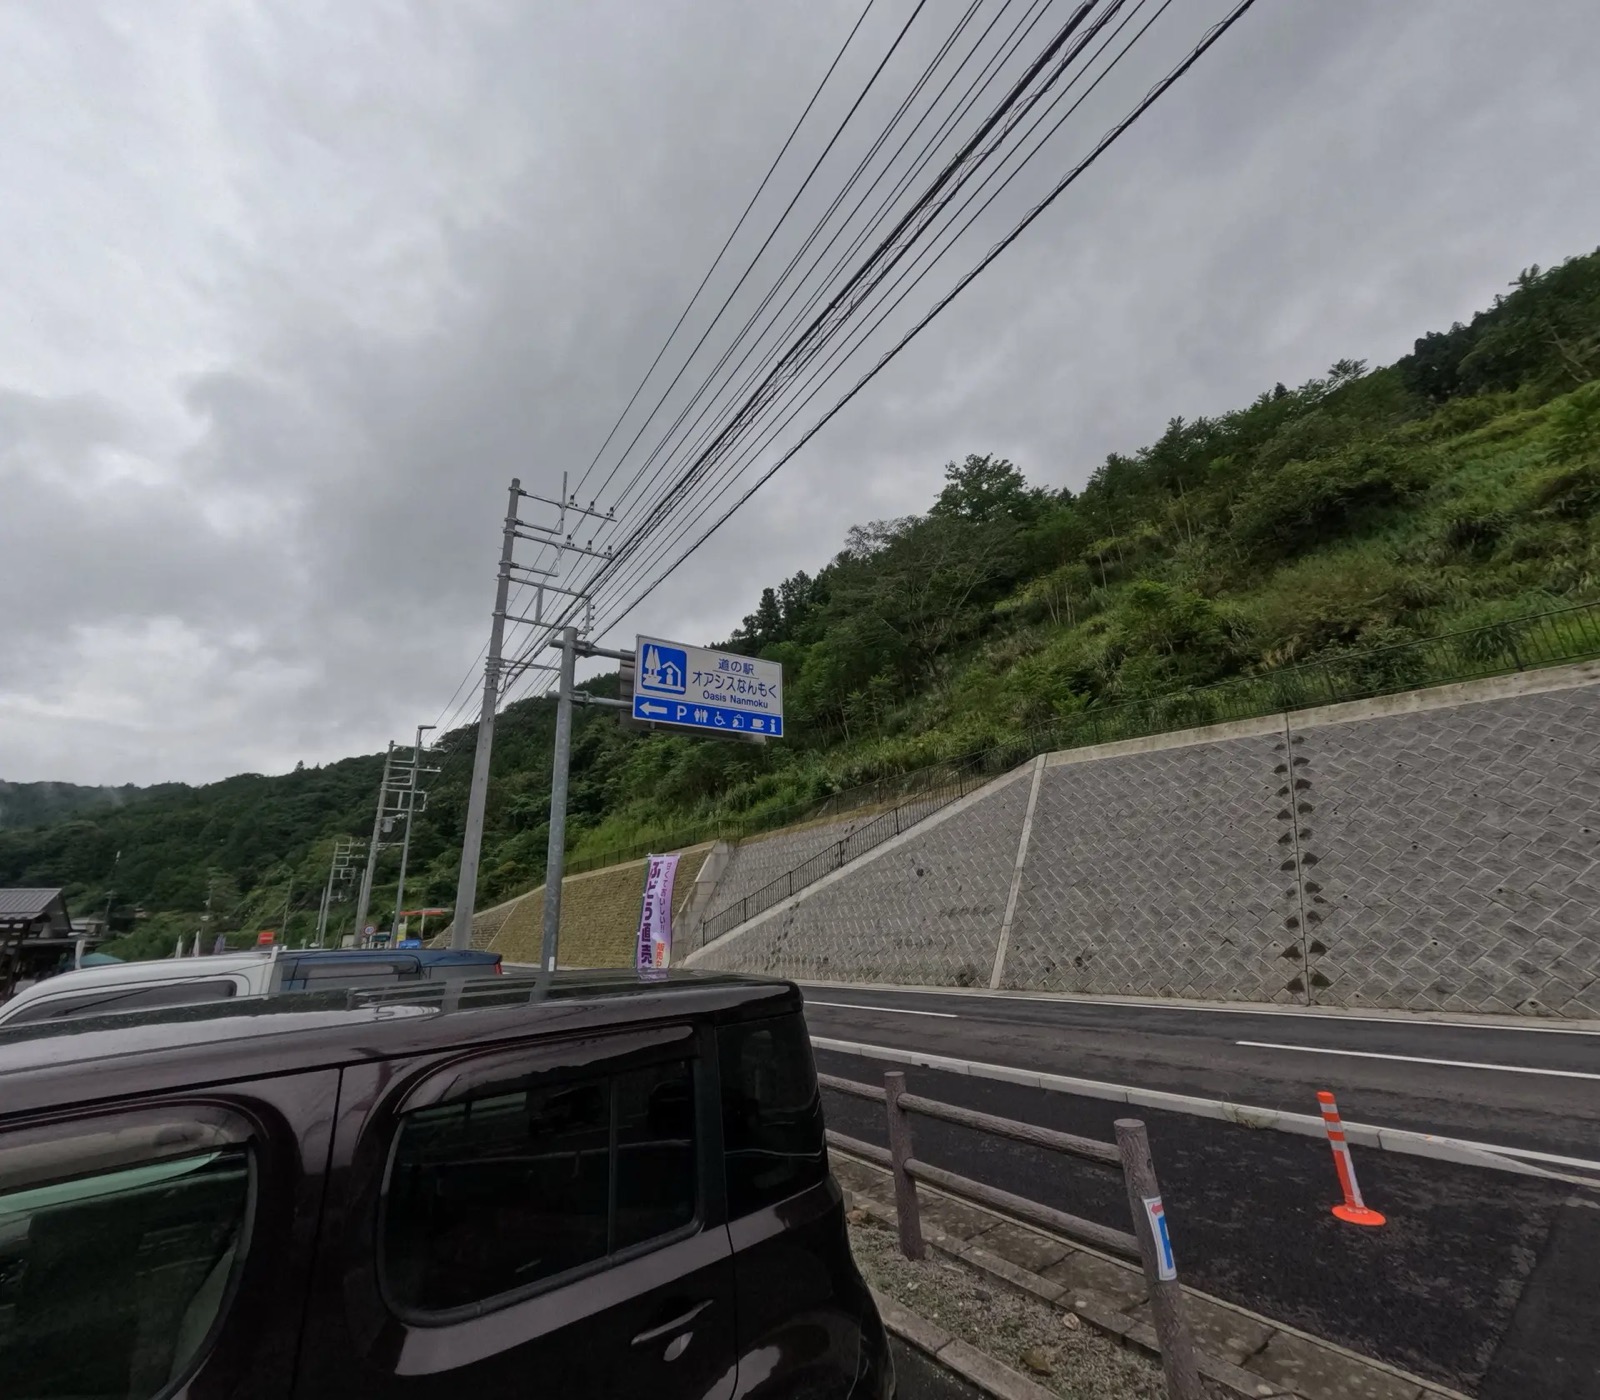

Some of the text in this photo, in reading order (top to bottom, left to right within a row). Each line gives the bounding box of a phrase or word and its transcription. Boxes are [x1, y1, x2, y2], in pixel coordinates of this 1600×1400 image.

[718, 658, 755, 676] 道の駅
[692, 671, 777, 698] オアシスなんもく
[702, 690, 769, 709] Oasis Nanmoku
[676, 705, 687, 720] P
[641, 860, 665, 968] ぶどう直売
